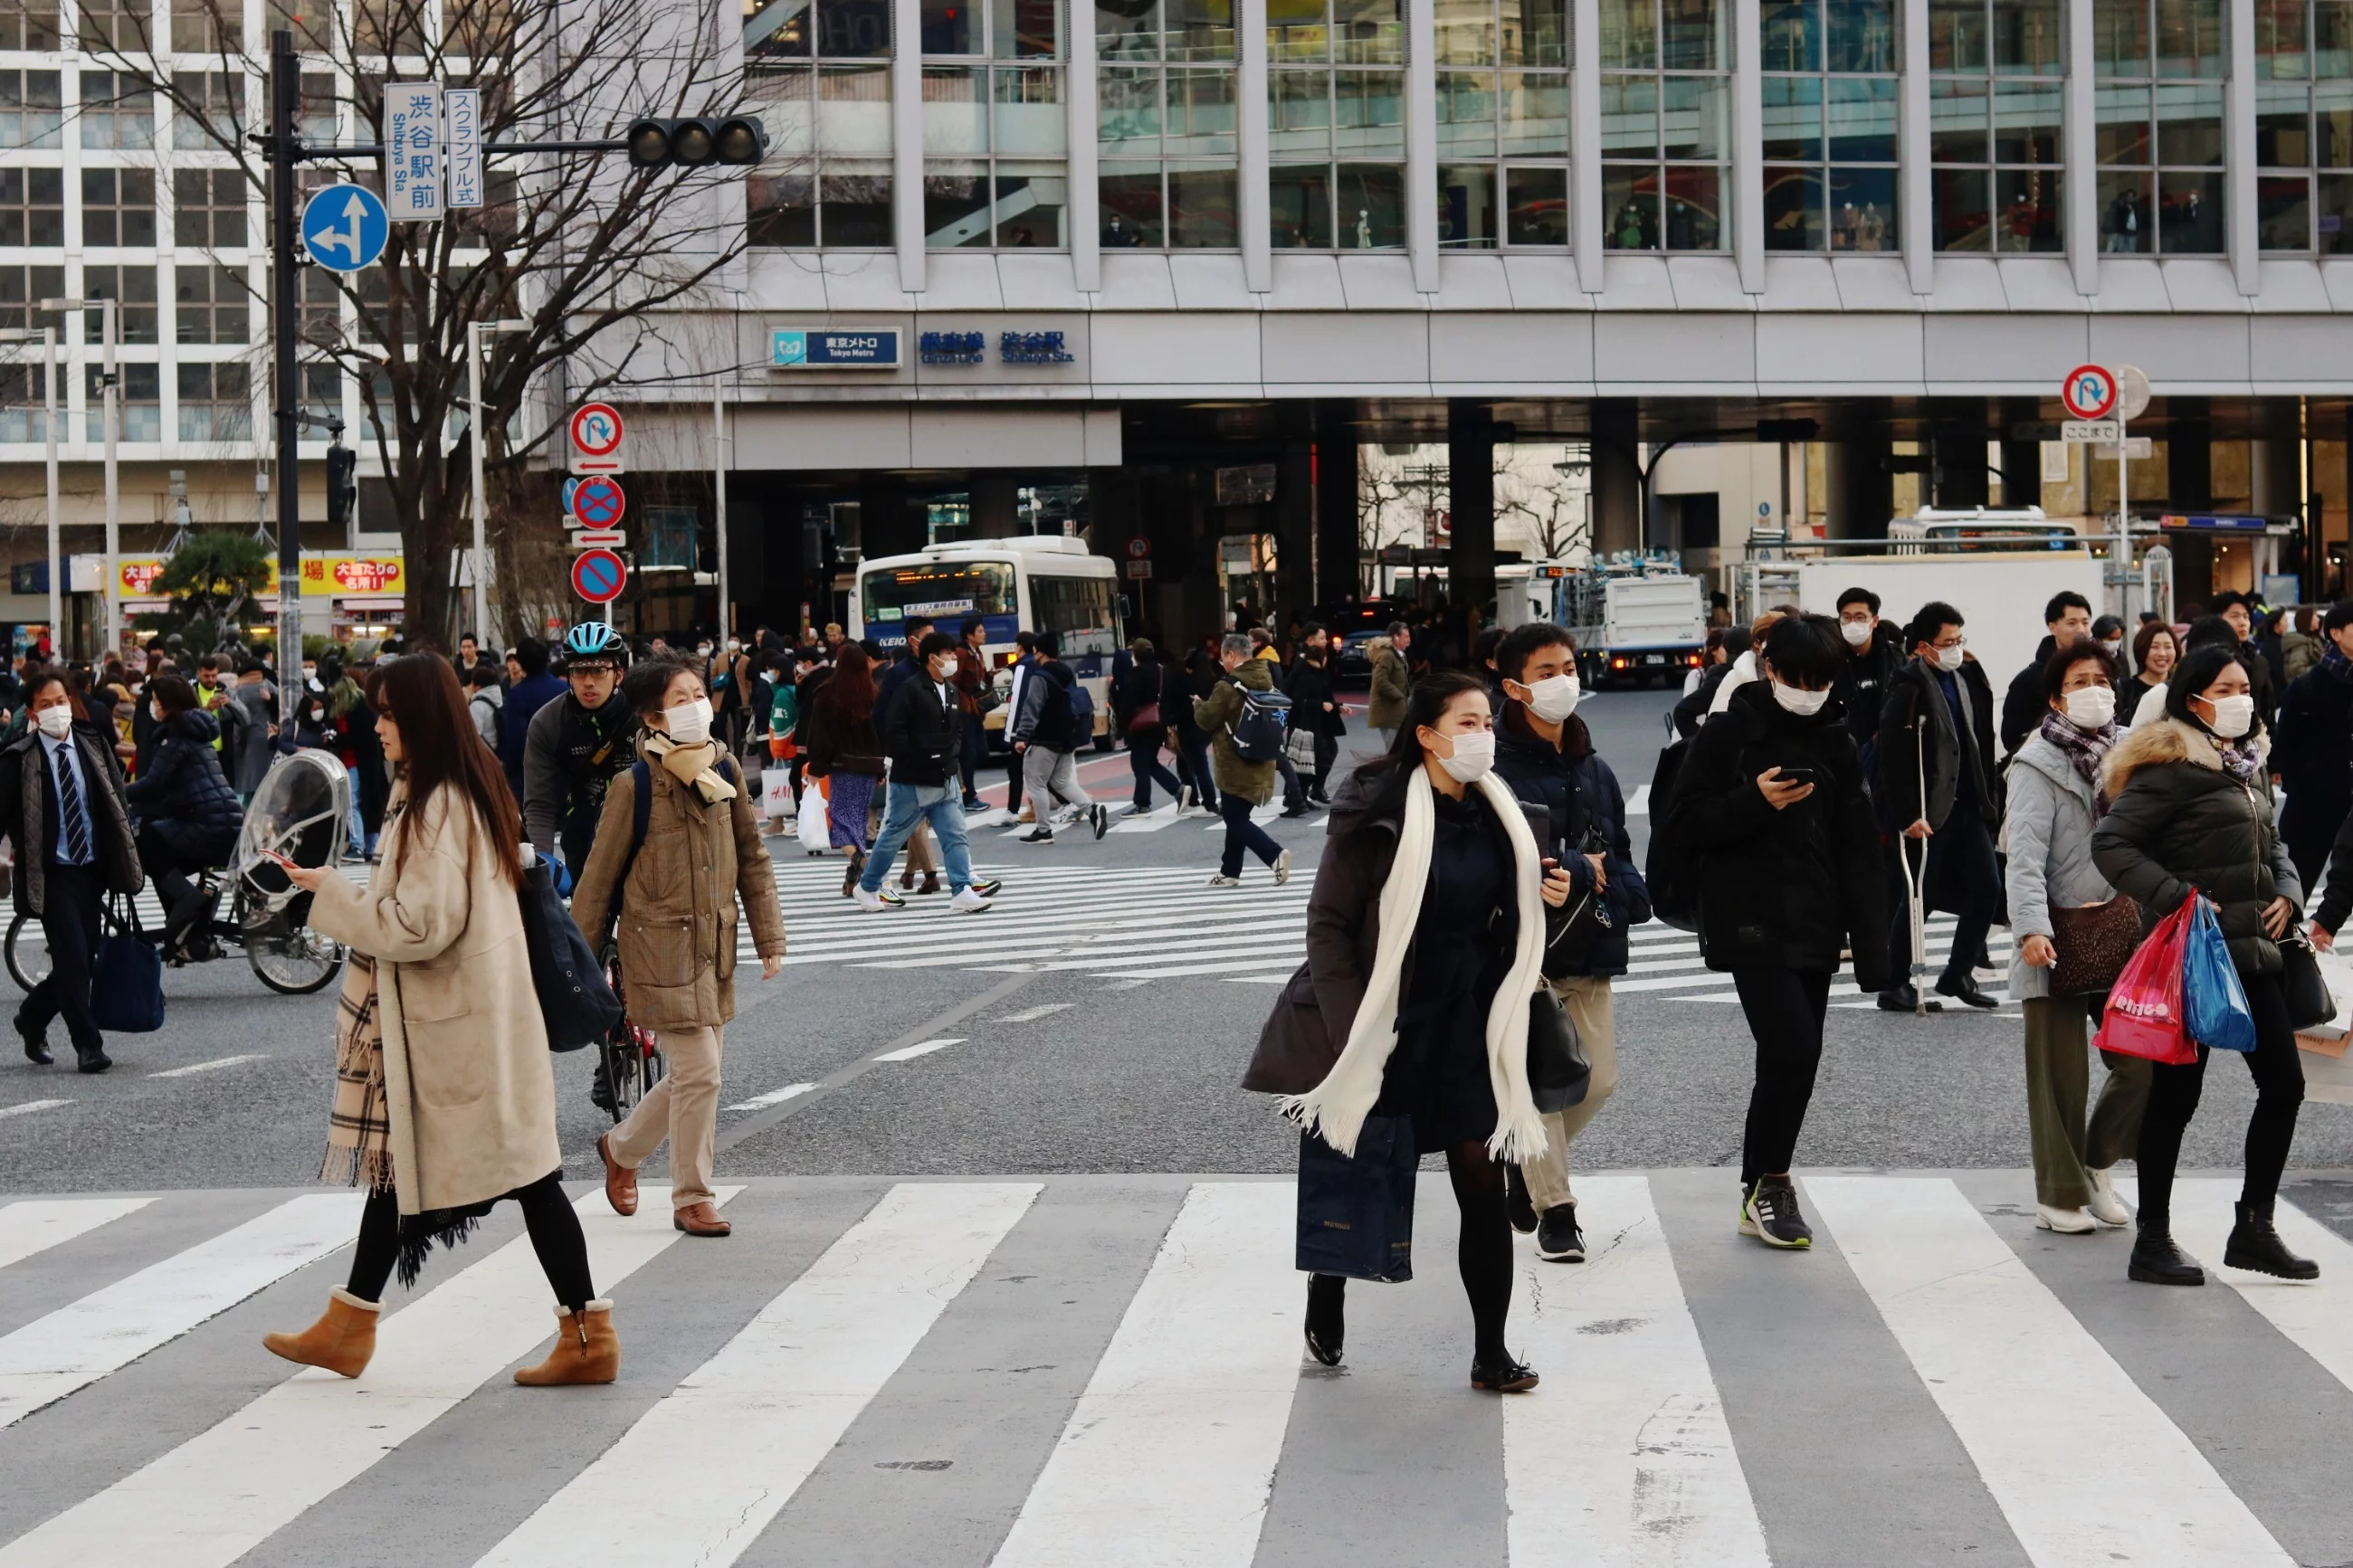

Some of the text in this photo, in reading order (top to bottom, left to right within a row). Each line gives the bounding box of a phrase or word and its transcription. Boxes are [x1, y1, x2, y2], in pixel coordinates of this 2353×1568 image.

[392, 113, 407, 196] Shibuya Sta.
[409, 94, 434, 209] 渋谷駅前
[454, 95, 474, 203] スクランブル式
[825, 337, 878, 348] 東京メトロ
[829, 348, 875, 358] Tokyo Metro
[2066, 426, 2114, 439] ここまで
[337, 562, 397, 576] 大当たりの
[879, 636, 907, 647] KEIO
